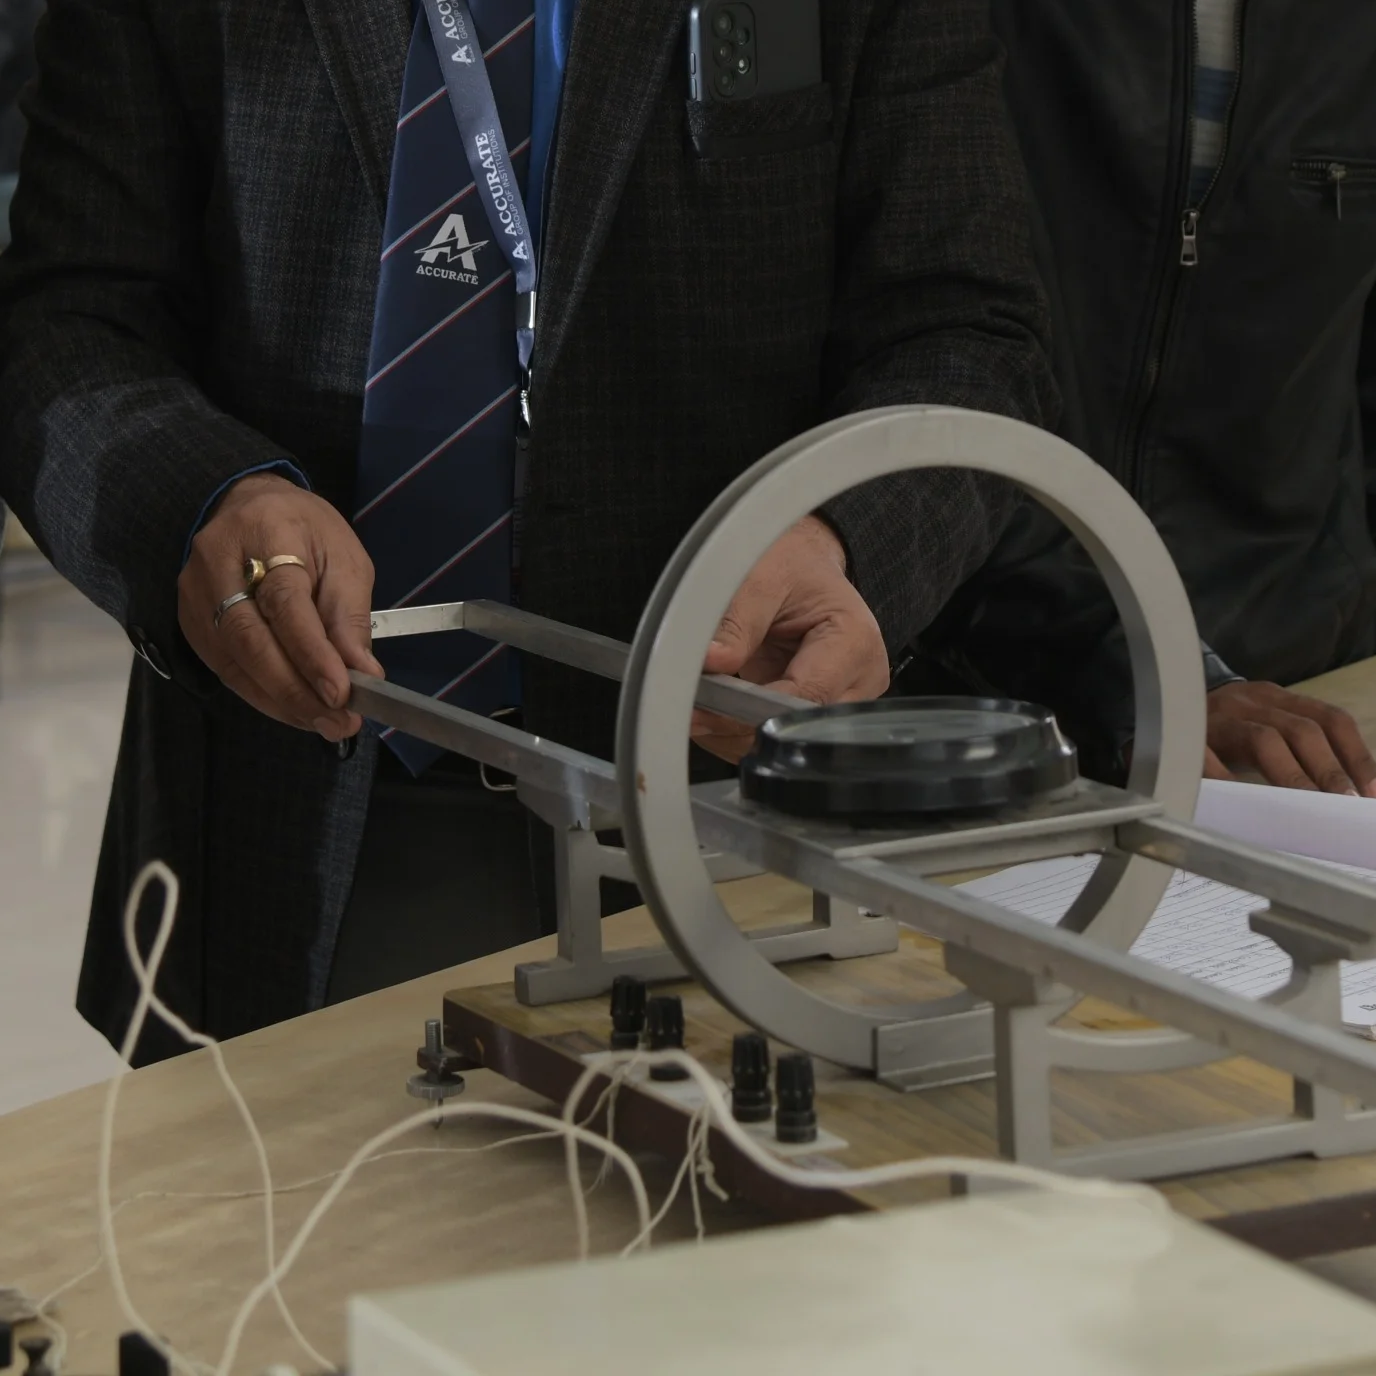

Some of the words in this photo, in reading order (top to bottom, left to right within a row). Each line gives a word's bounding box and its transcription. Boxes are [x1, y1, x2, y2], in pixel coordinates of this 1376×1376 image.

[488, 128, 511, 189] INSTITUTIONS
[474, 132, 518, 236] ACCURATE
[509, 203, 524, 235] GROUP
[415, 264, 479, 285] ACCURATE
